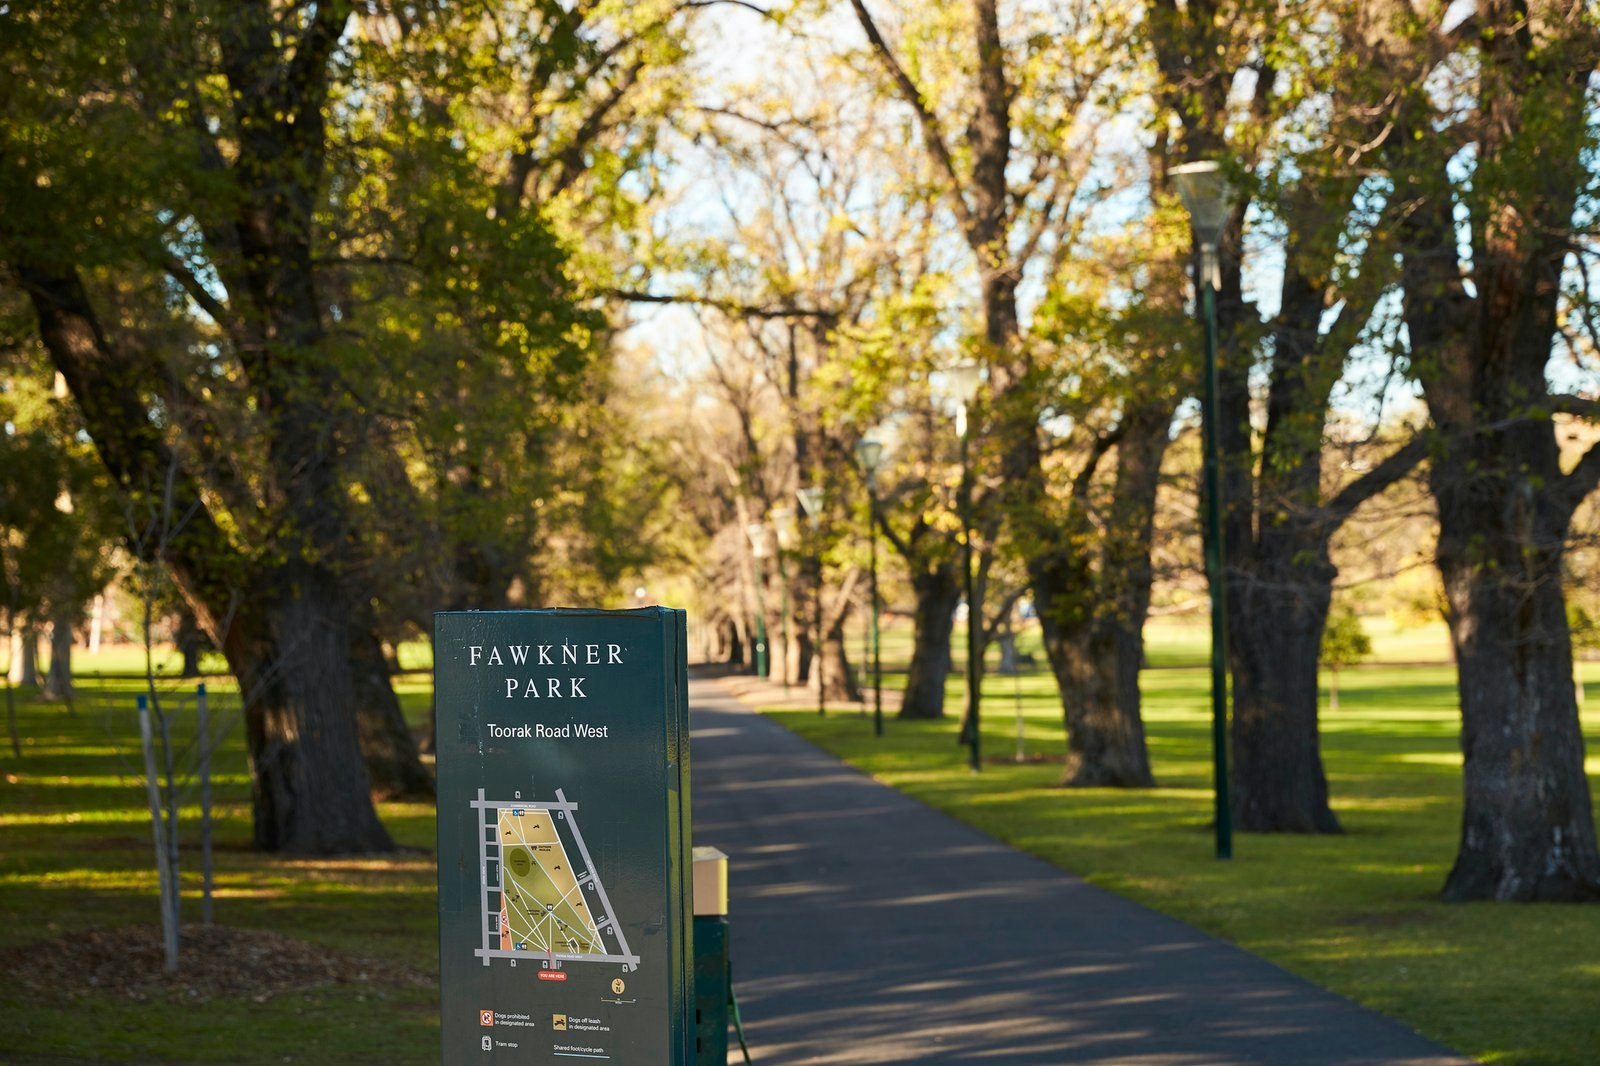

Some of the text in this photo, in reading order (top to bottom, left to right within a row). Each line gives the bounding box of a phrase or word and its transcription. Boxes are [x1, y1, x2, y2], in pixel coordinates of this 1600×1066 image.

[469, 644, 624, 665] FAWKNER
[506, 678, 587, 698] PARK
[488, 724, 608, 738] Toorak Road West
